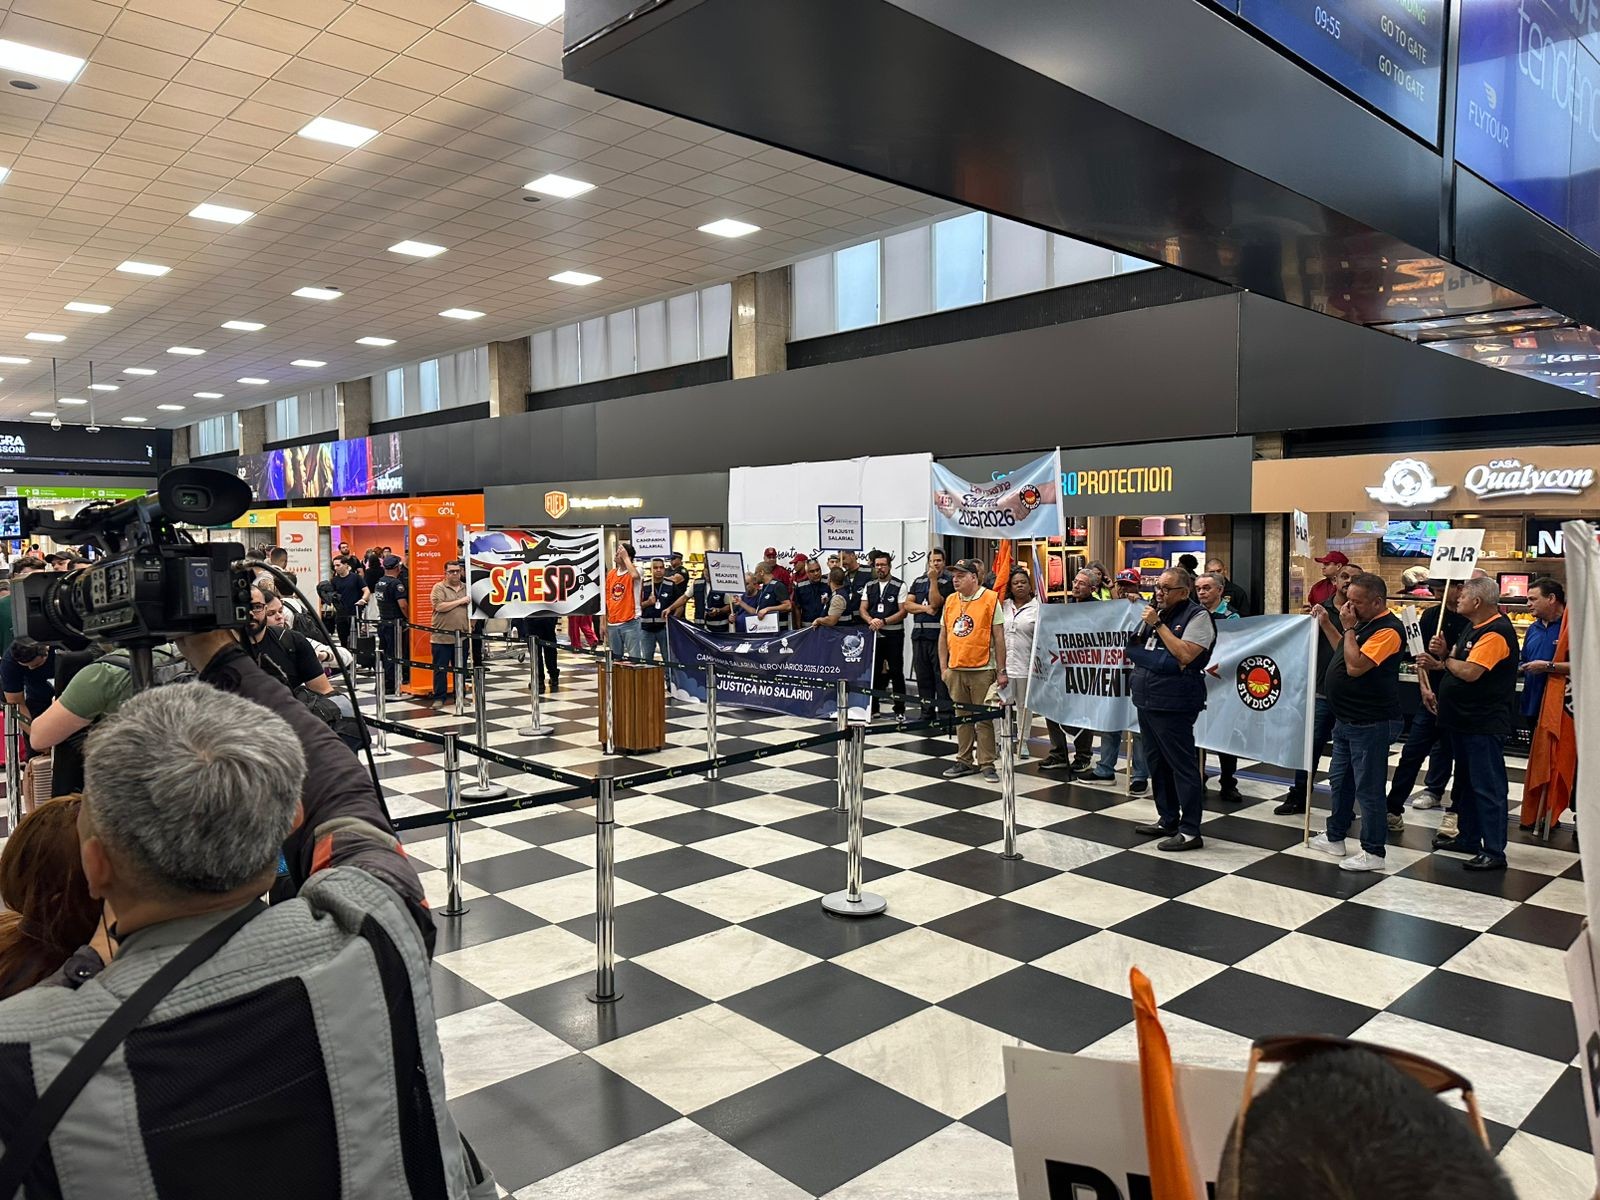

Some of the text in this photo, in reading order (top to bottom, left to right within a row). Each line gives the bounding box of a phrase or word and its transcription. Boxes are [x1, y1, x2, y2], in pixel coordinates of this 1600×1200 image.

[1315, 6, 1340, 39] 09:55
[1381, 15, 1427, 64] GO TO GATE
[1379, 55, 1424, 101] GO TO GATE
[1469, 100, 1509, 148] FLYTOUR
[0, 446, 26, 454] SONI
[1489, 460, 1520, 469] CASA
[1060, 466, 1172, 496] ROPROTECTION
[1464, 464, 1596, 495] Qualycon
[389, 503, 408, 521] GOL
[438, 507, 455, 516] GOL
[959, 508, 1015, 528] 2025/2026
[1296, 525, 1308, 542] PLR
[1436, 546, 1476, 562] PLR
[490, 566, 576, 604] SAESP
[1060, 649, 1102, 664] EXIGEM
[1240, 656, 1276, 675] FORÇA
[760, 662, 802, 672] AEROVIÁRIOS
[804, 664, 840, 674] 2025/2026
[716, 680, 812, 700] JUSTIÇA NO SALÁRIO!
[1066, 666, 1132, 697] AUMENT
[1238, 683, 1279, 709] SINDICAL
